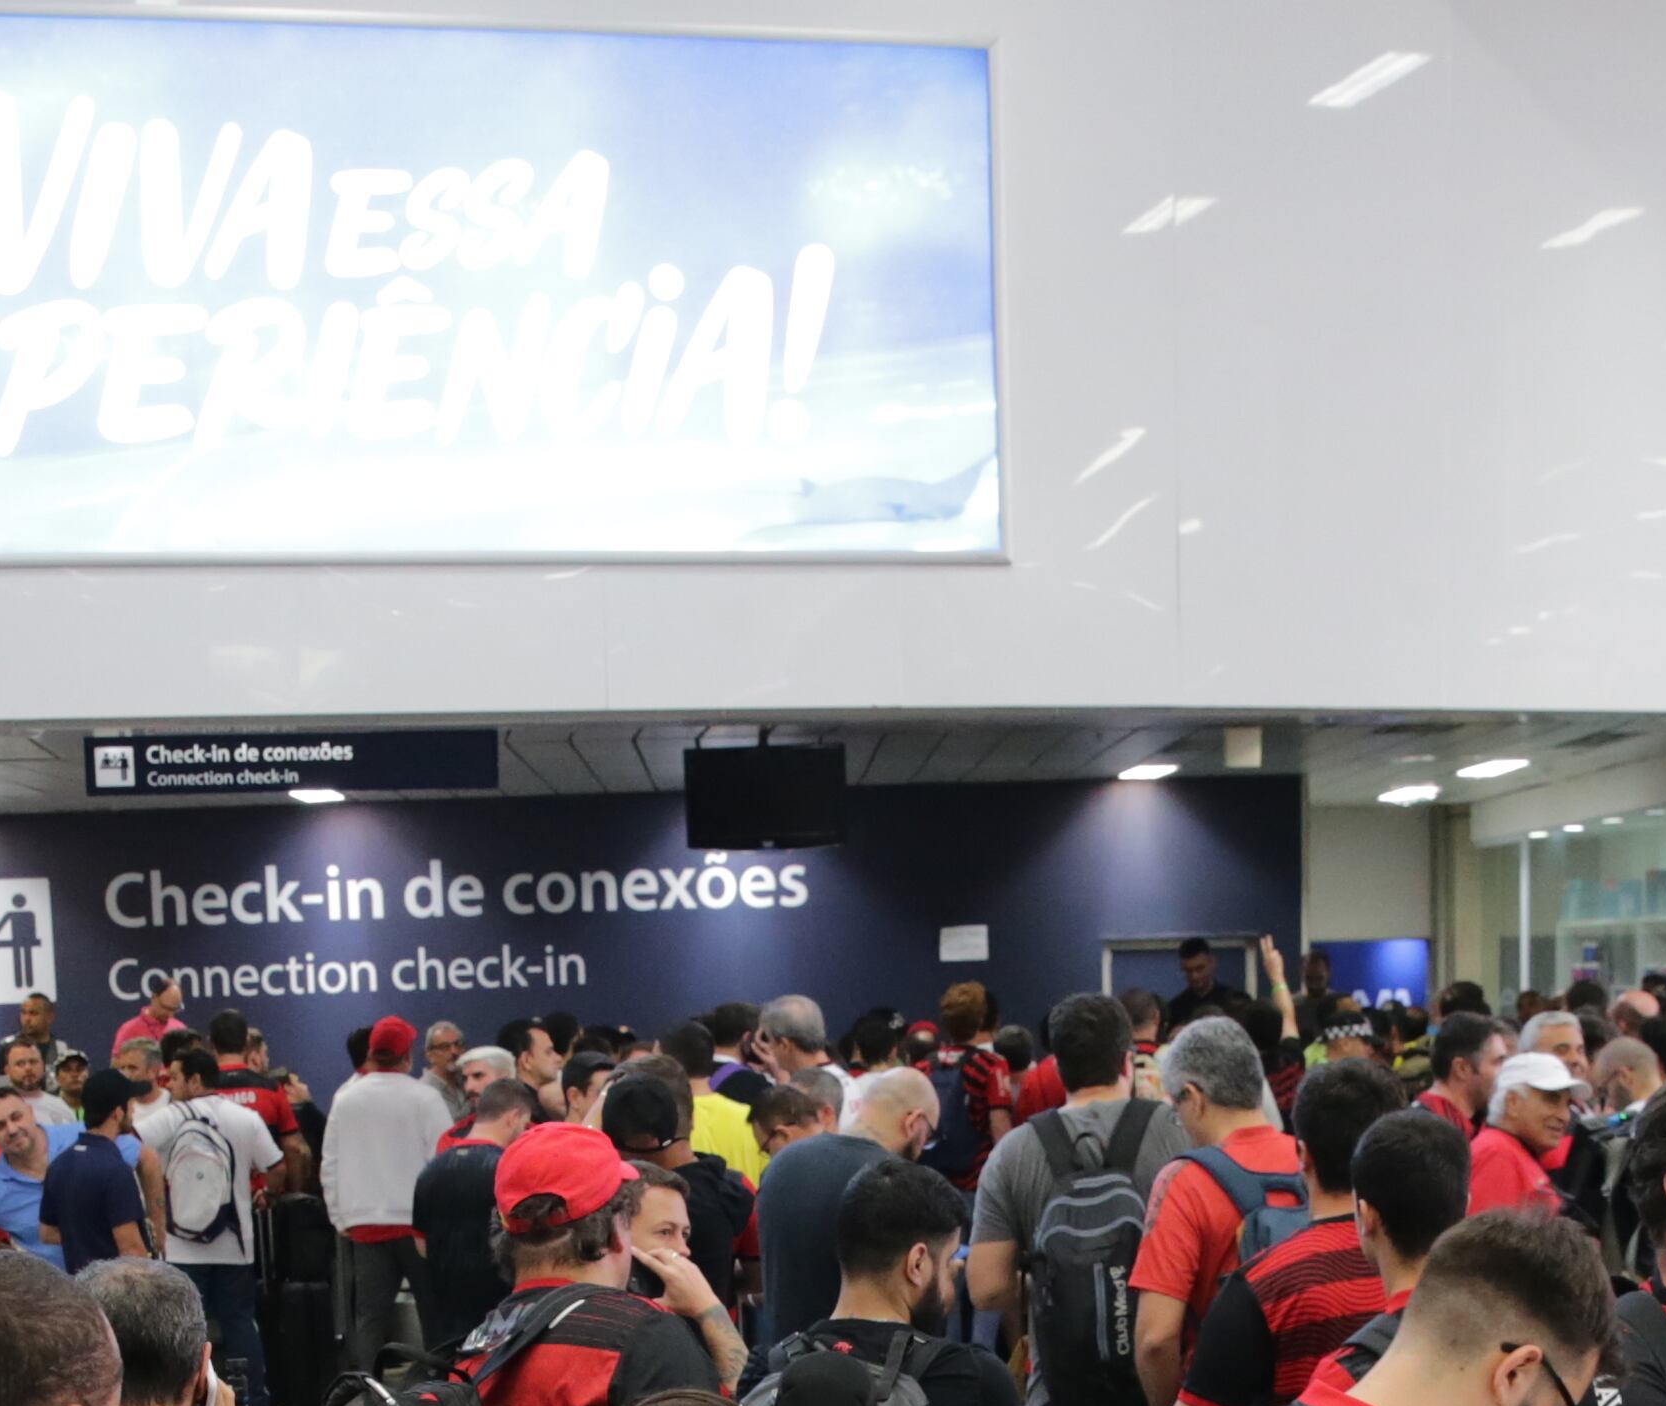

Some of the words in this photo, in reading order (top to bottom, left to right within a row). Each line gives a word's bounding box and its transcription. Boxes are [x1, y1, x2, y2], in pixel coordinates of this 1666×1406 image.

[322, 148, 610, 279] ESSA
[145, 743, 231, 765] Check-in
[234, 743, 259, 763] de
[262, 742, 354, 762] conexões
[146, 769, 233, 787] Connection
[236, 768, 300, 785] check-in
[104, 864, 384, 930] Check-in
[405, 859, 484, 919] de
[503, 853, 808, 915] conexões
[108, 952, 380, 1000] Connection
[391, 944, 587, 993] check-in
